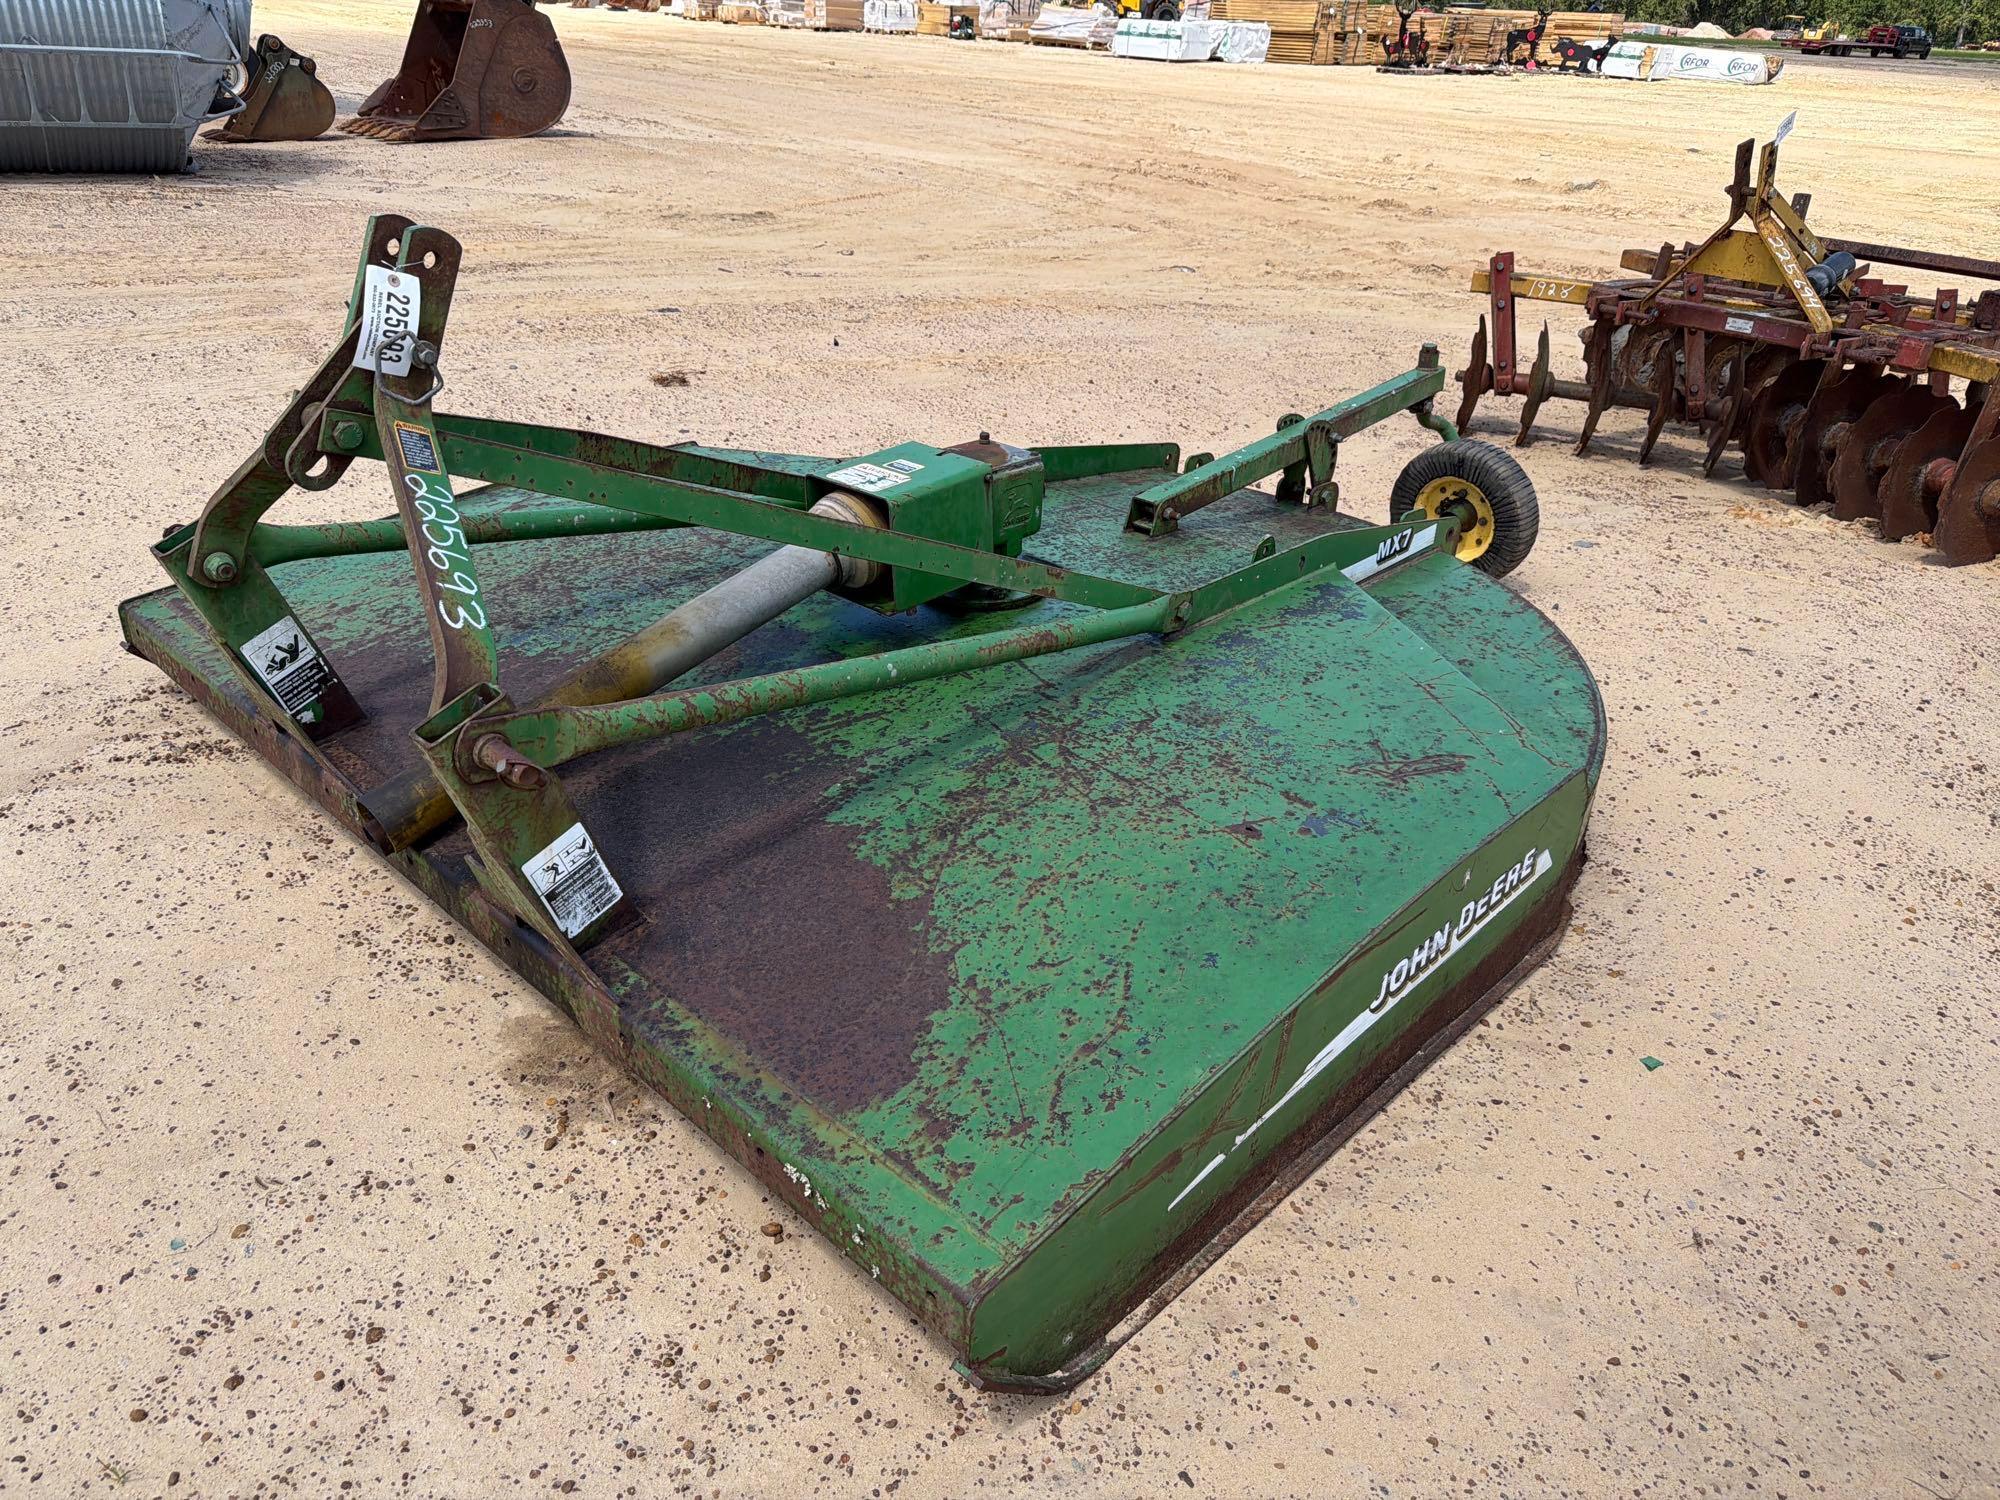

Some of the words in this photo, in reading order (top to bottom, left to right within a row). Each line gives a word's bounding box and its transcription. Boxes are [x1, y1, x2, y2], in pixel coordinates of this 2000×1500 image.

[1528, 280, 1576, 299] 1928
[1767, 235, 1822, 308] 225694
[374, 310, 382, 332] AUCTION
[369, 334, 379, 357] COMPANY
[404, 473, 487, 630] 225693
[1376, 527, 1413, 564] MX7
[1370, 920, 1452, 1014] JOHN
[1455, 847, 1538, 941] DEERE
